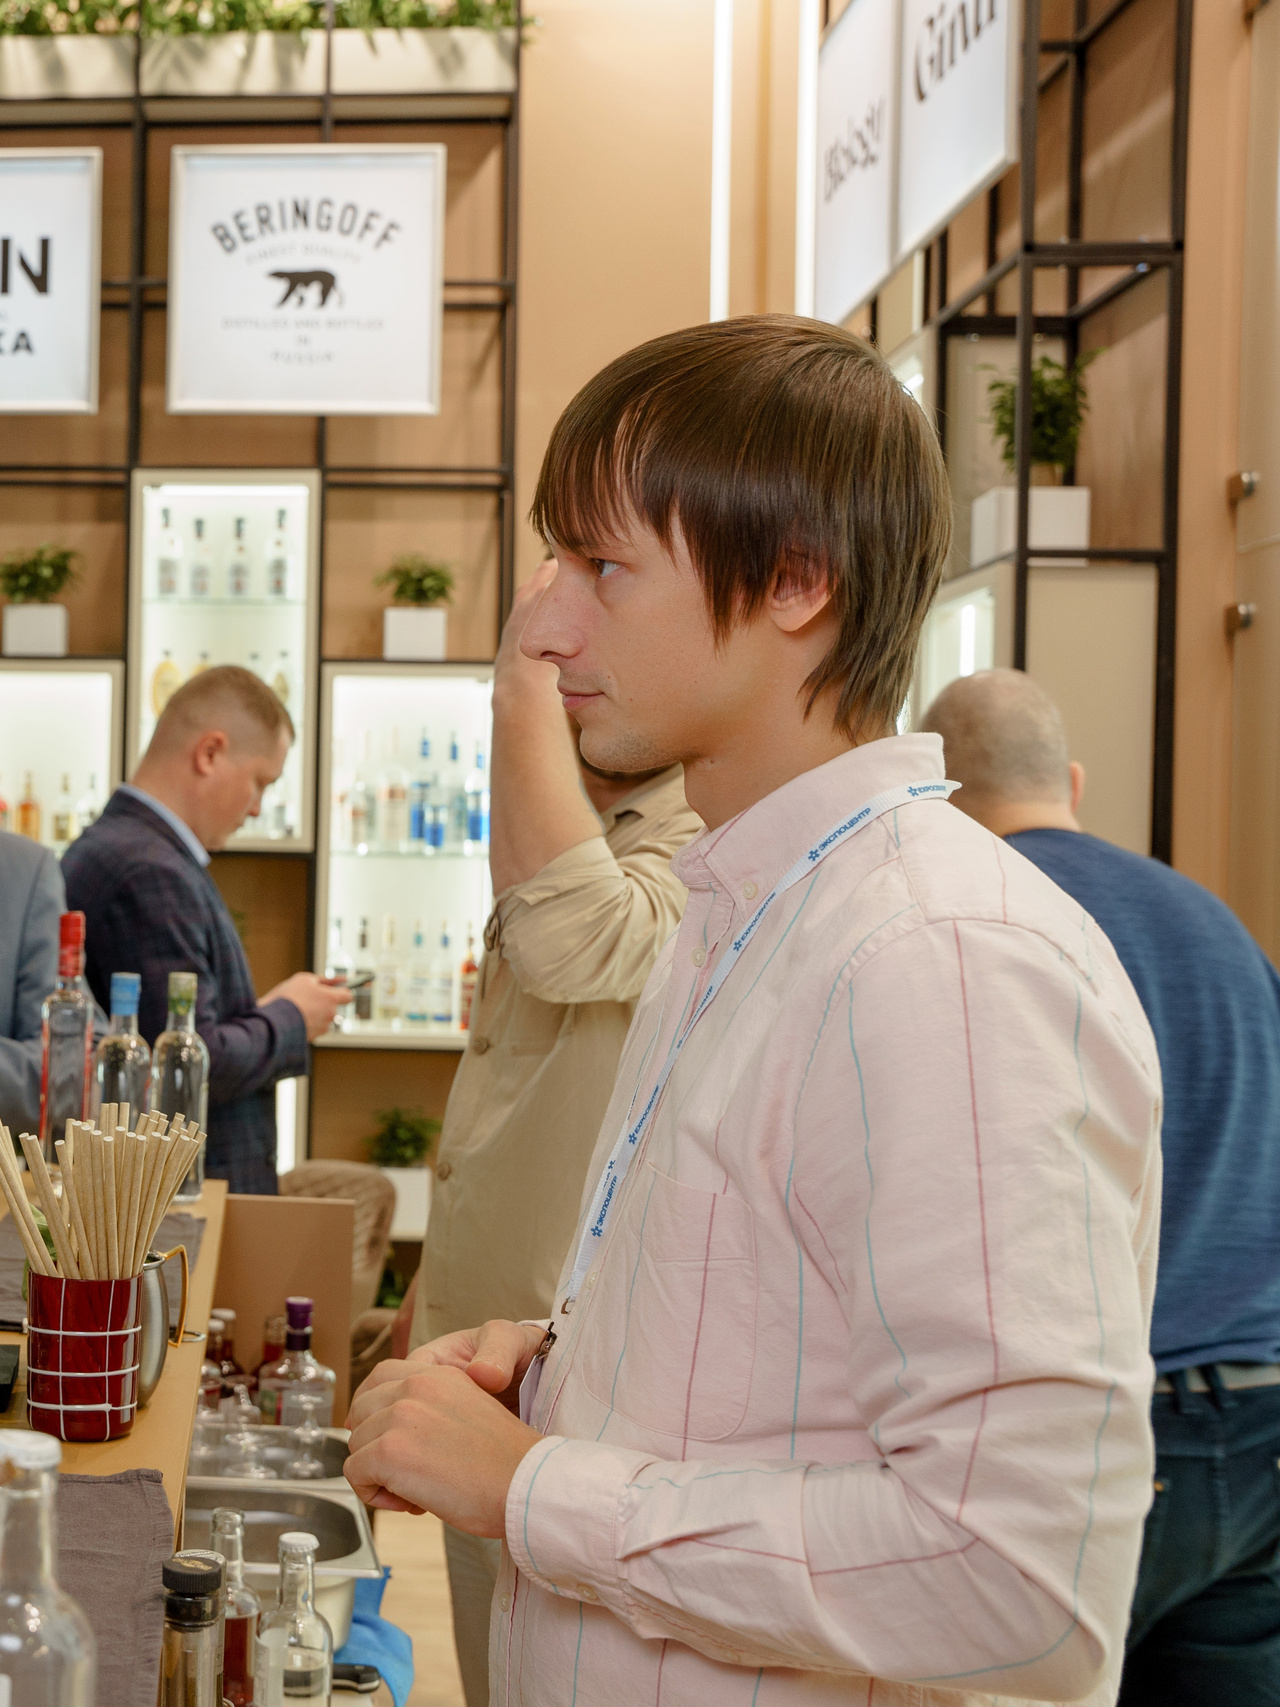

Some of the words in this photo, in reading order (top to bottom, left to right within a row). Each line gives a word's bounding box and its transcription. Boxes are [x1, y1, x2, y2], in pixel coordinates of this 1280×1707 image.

[211, 196, 401, 254] BERINGOFF
[818, 807, 871, 851] ЭКСПОЦЕНТР
[740, 891, 776, 941] EXPOCENTRE
[634, 1085, 659, 1134] EXPOCENTRE
[596, 1175, 618, 1227] ЭКСПОЦЕНТР
